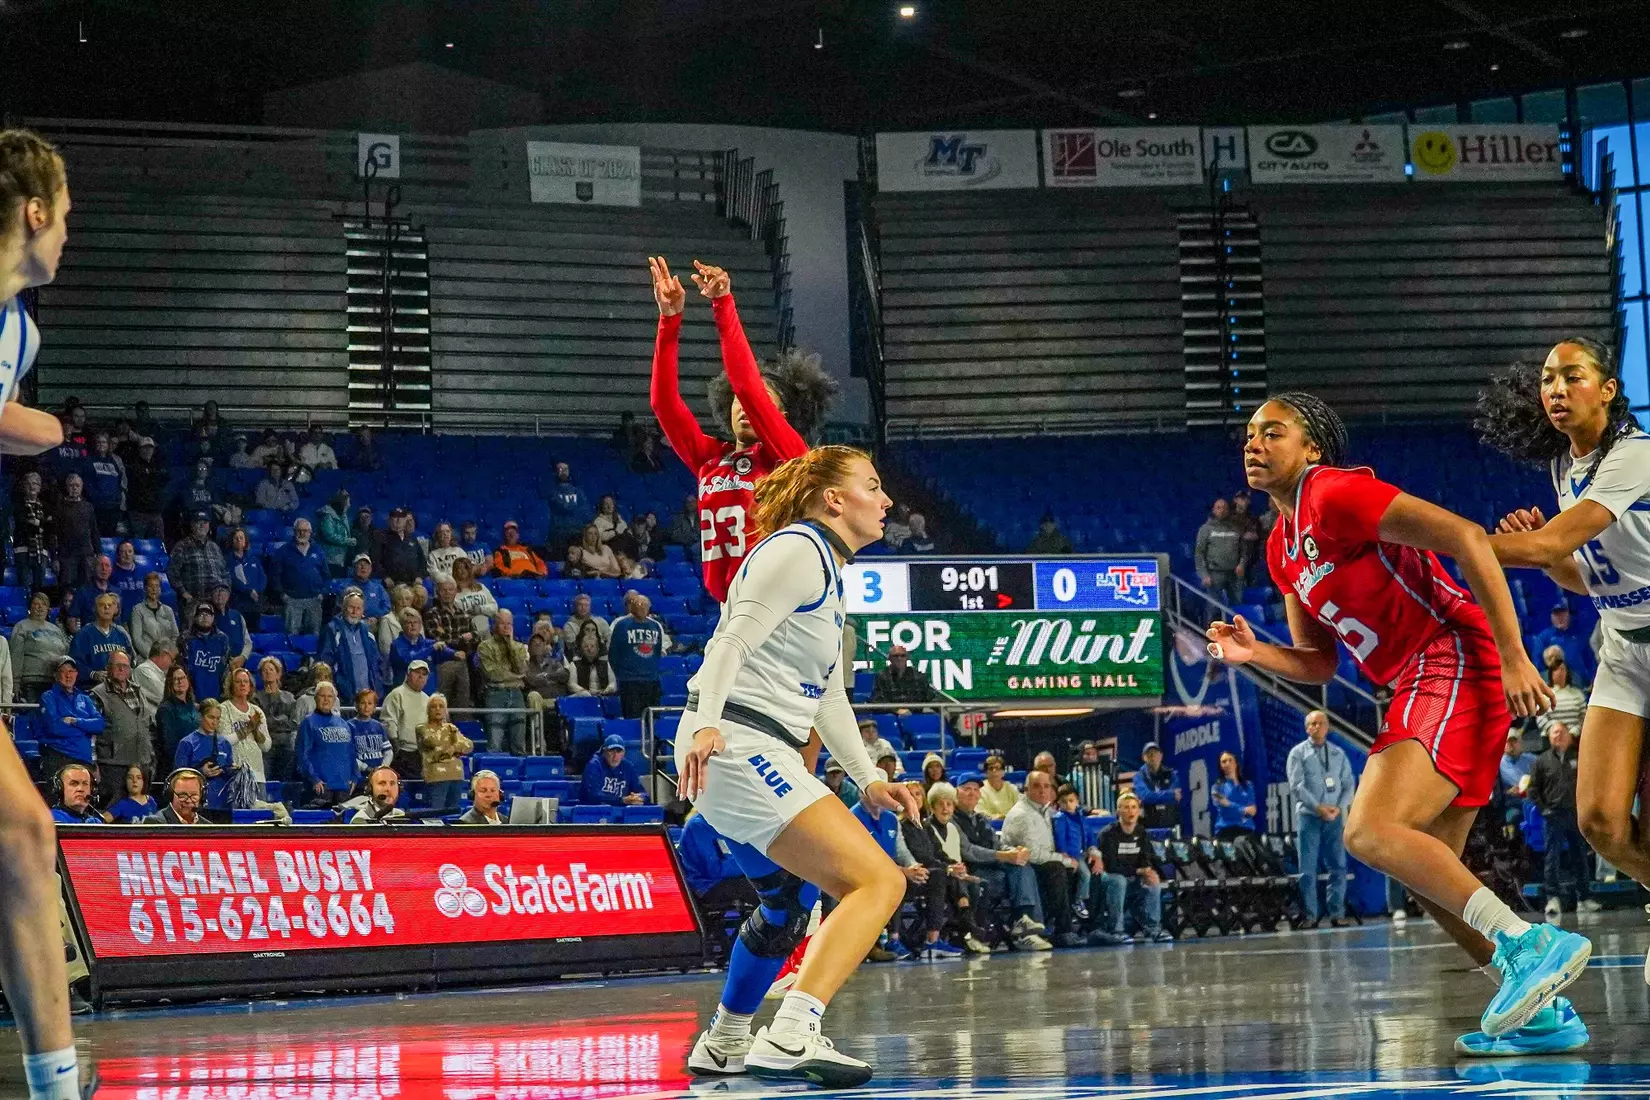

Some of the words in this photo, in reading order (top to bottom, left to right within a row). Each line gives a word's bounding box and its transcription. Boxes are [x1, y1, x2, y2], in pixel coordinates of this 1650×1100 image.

[367, 141, 391, 169] G
[926, 134, 988, 176] MT
[1098, 139, 1131, 158] Ole
[1135, 138, 1194, 158] South
[1213, 135, 1236, 161] H
[1458, 134, 1559, 164] Hiller
[1290, 161, 1329, 171] AUTO
[701, 505, 746, 562] 23
[862, 570, 883, 603] 3
[941, 565, 999, 592] 9:01
[1052, 568, 1077, 602] 0
[959, 595, 984, 610] 1st
[866, 621, 952, 652] FOR
[1005, 617, 1155, 667] Mint
[1007, 675, 1082, 690] GAMING
[1090, 674, 1138, 688] HALL
[1175, 721, 1220, 756] MIDDLE
[748, 753, 793, 799] BLUE
[117, 850, 269, 896] MICHAEL
[273, 849, 374, 893] BUSEY
[129, 892, 395, 944] 615-624-8664
